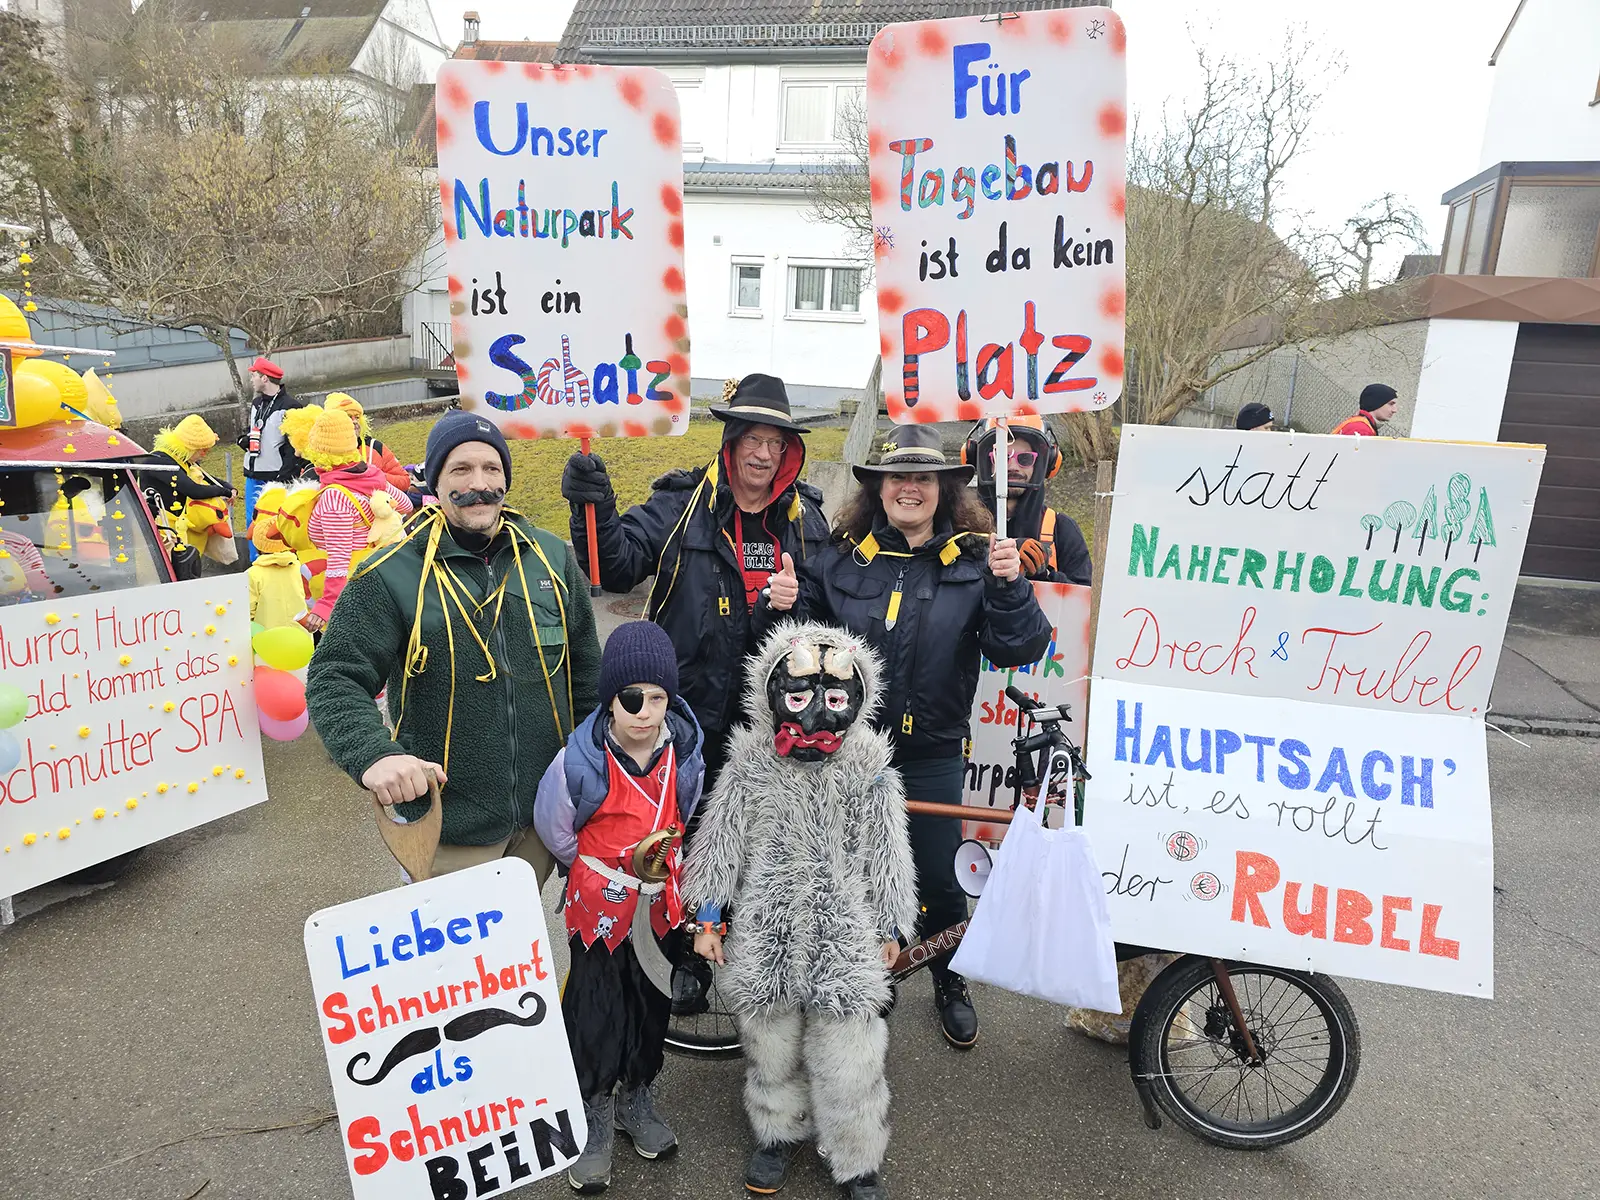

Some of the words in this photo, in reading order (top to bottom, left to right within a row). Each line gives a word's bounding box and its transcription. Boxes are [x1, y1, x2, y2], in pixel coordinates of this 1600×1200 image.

[953, 43, 1031, 119] Für
[474, 101, 608, 158] Unser
[889, 134, 1094, 219] Tagebau
[454, 178, 634, 248] Naturpark
[918, 237, 959, 281] ist
[985, 221, 1031, 273] da
[1053, 215, 1114, 269] kein
[471, 272, 509, 316] ist
[541, 279, 582, 313] ein
[485, 332, 674, 412] Schatz
[903, 300, 1099, 407] Platz
[1176, 445, 1339, 511] statt
[743, 556, 776, 569] ULLS
[1128, 523, 1490, 616] NAHERHOLUNG:
[95, 607, 183, 650] Hurra
[1115, 606, 1258, 678] Dreck
[1271, 631, 1289, 662] &
[1301, 622, 1483, 713] Trubel.
[25, 674, 71, 719] ald
[88, 658, 165, 704] kommt
[175, 650, 220, 684] das
[175, 689, 243, 753] SPA
[1123, 772, 1190, 814] ist,
[1202, 790, 1250, 820] es
[1268, 796, 1389, 851] rollt
[1101, 843, 1174, 902] der
[335, 908, 503, 980] Lieber
[322, 939, 549, 1045] Schnurrbart
[410, 1048, 474, 1095] als
